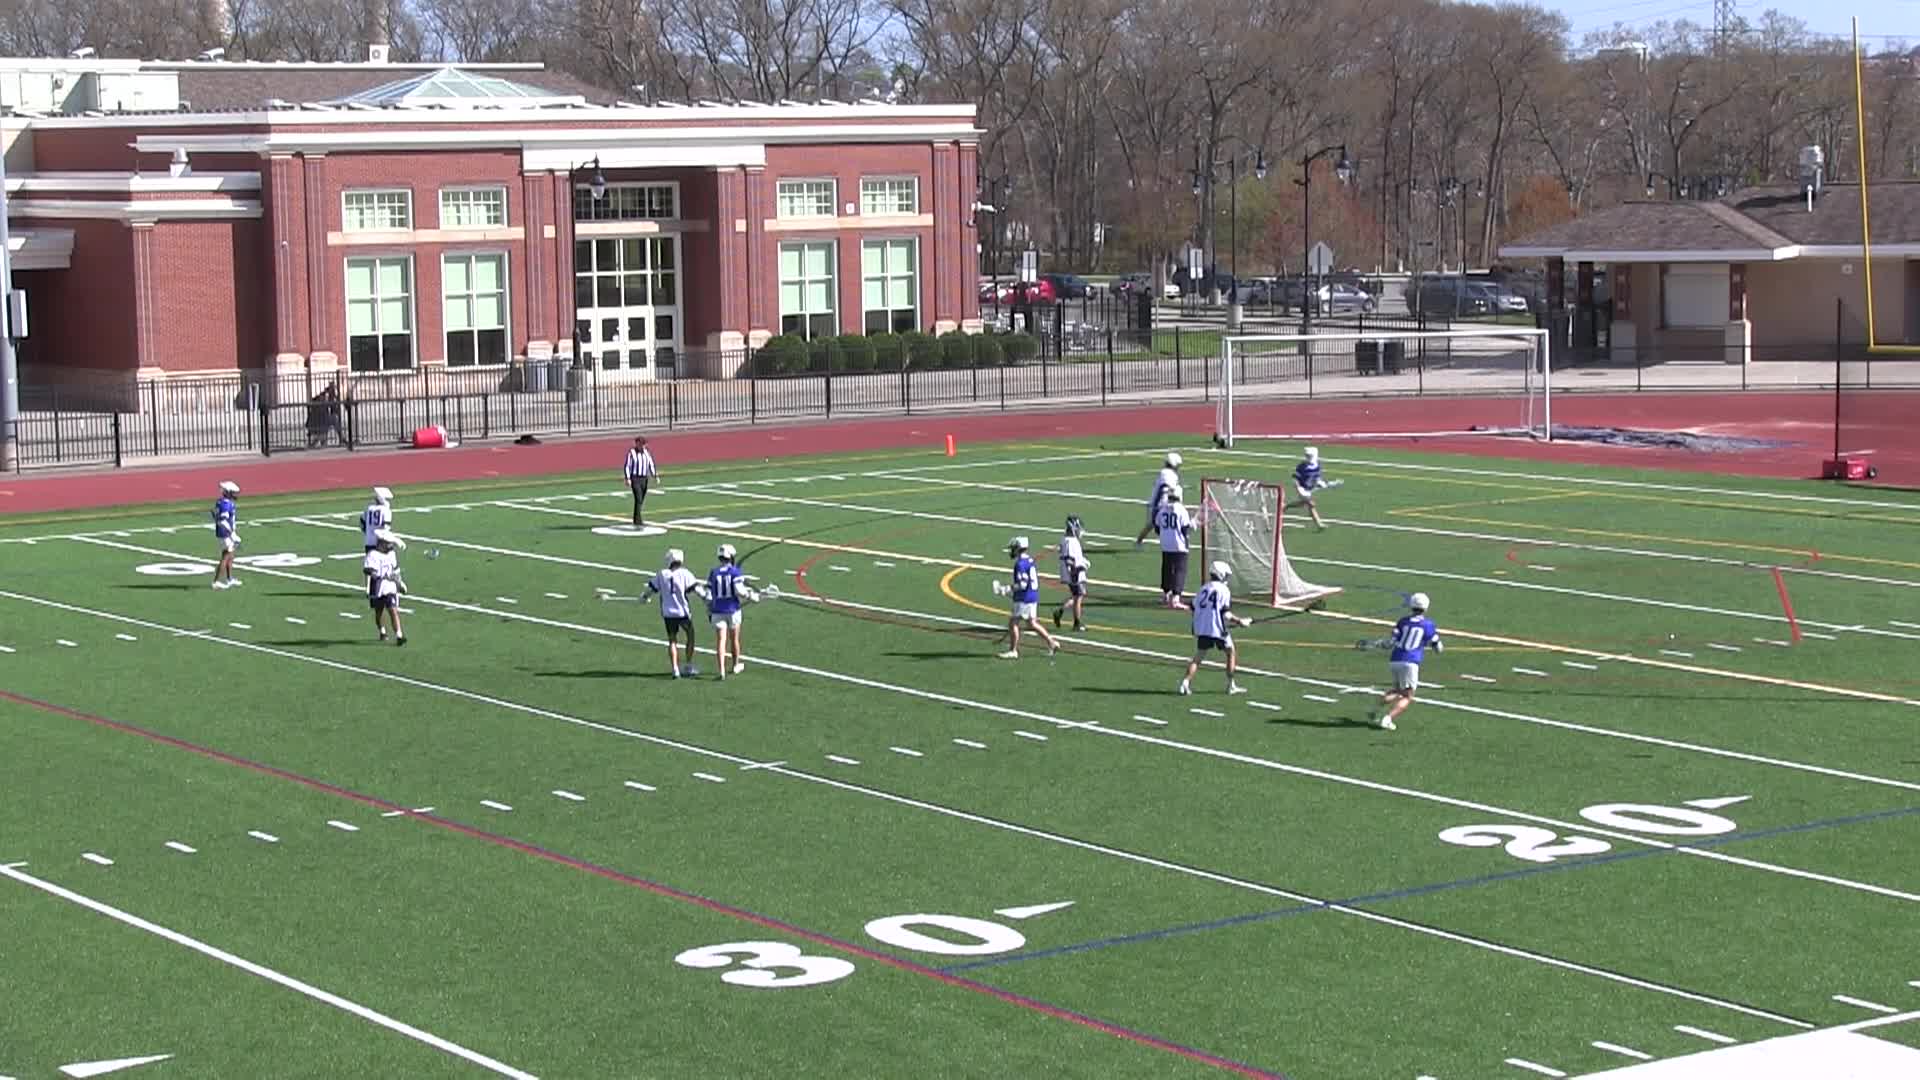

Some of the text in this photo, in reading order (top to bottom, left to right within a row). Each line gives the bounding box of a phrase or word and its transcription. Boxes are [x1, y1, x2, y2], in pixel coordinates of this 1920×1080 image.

[368, 510, 381, 526] 19
[1161, 512, 1178, 529] 30
[716, 575, 732, 598] 11
[1200, 590, 1218, 609] 24
[1398, 625, 1425, 651] 10
